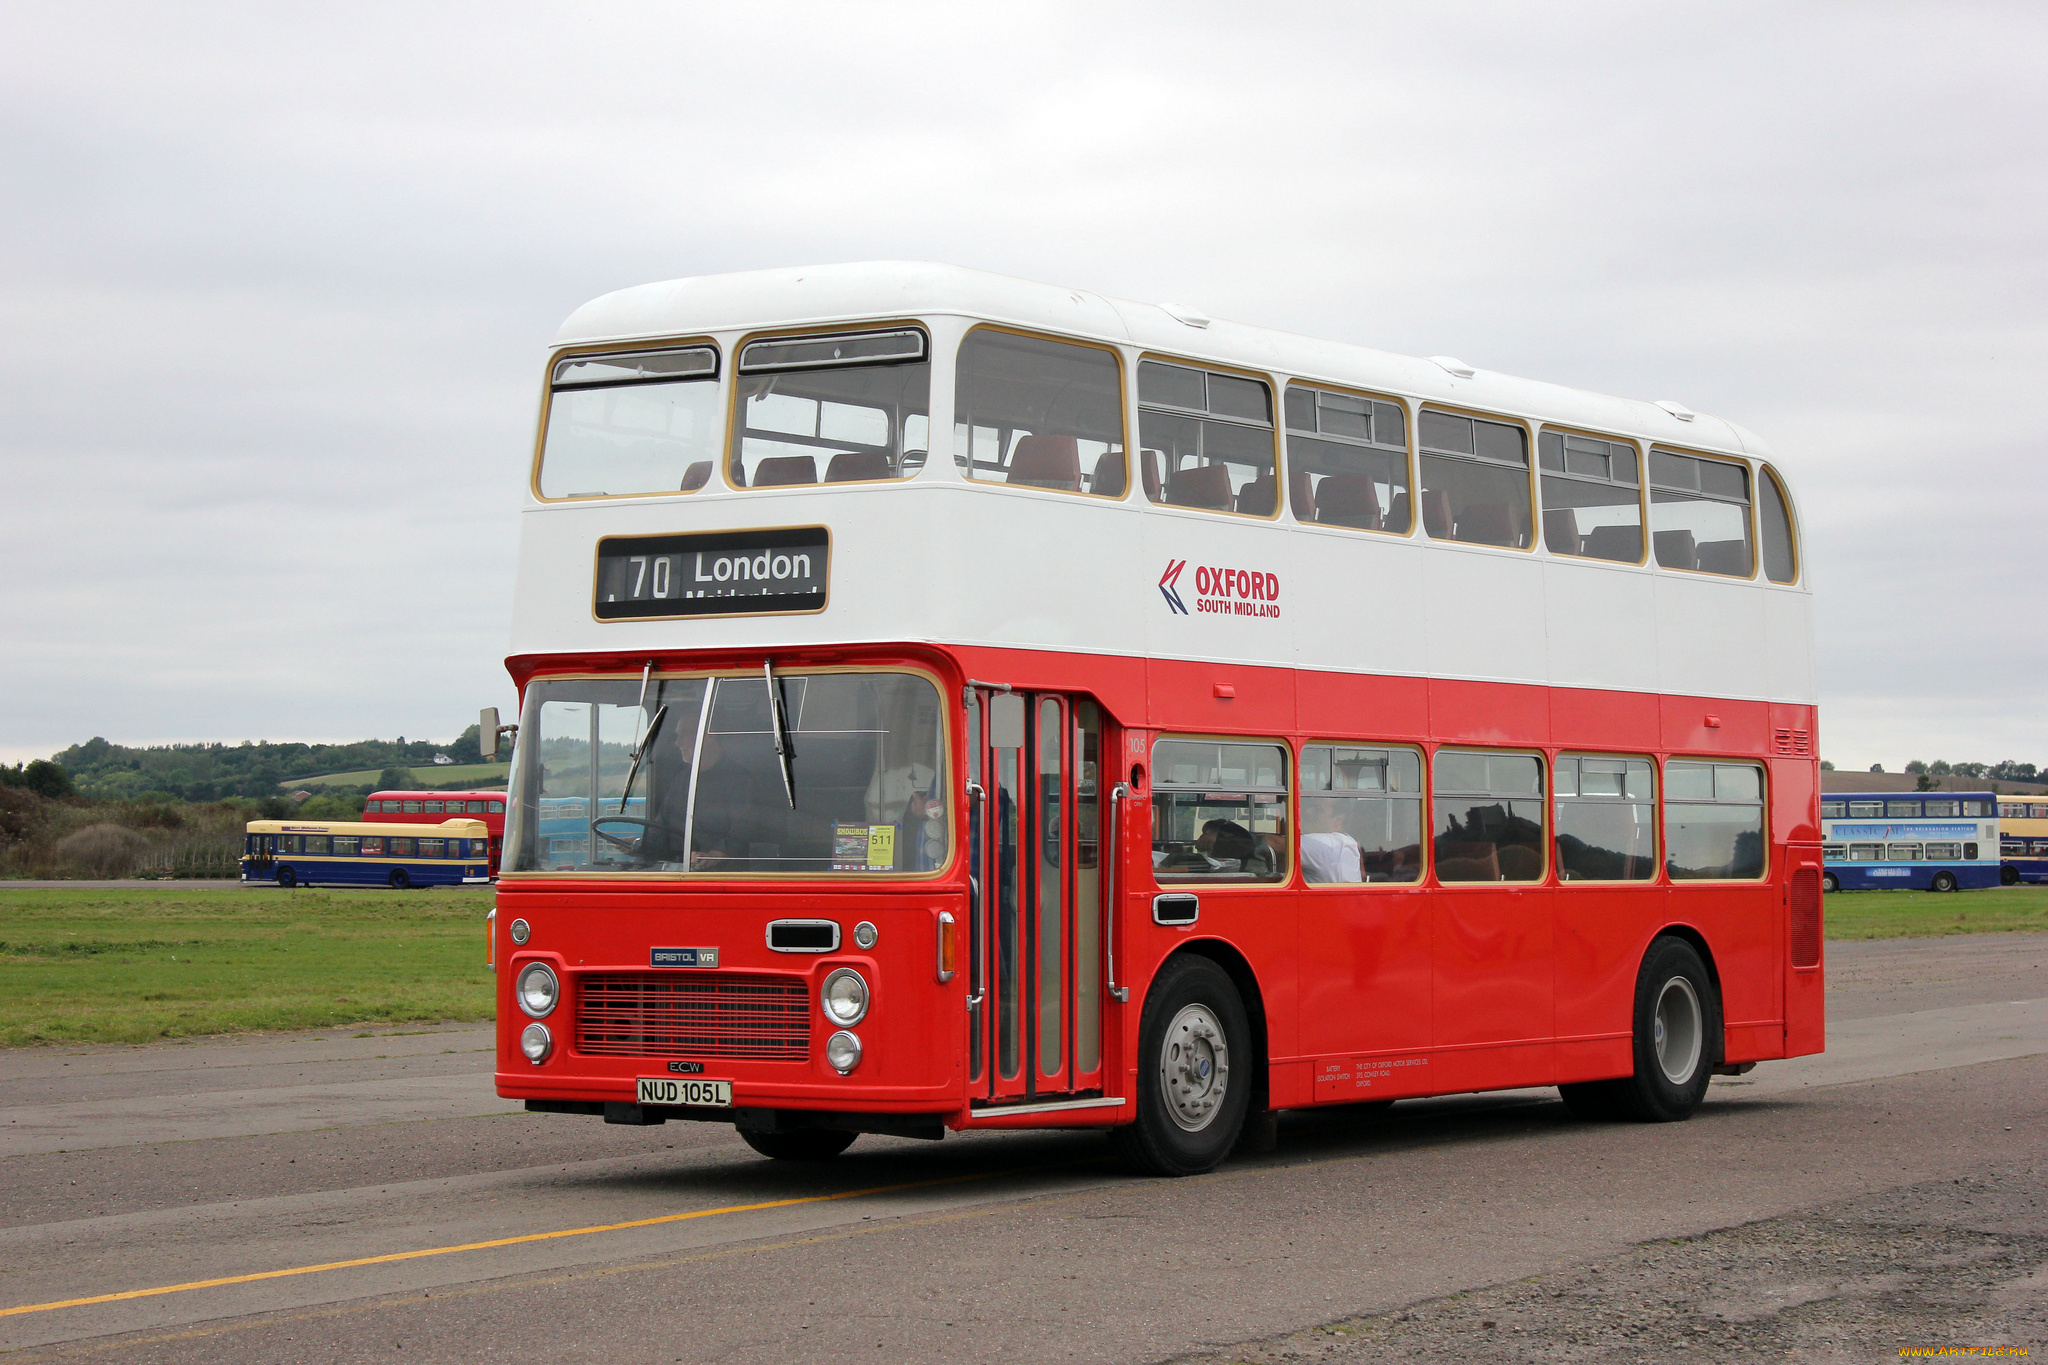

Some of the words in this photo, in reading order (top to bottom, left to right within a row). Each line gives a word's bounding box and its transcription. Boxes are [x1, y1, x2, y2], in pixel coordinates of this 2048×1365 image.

[629, 556, 671, 598] 70
[695, 549, 811, 582] London
[1195, 566, 1279, 601] OXFORD
[1197, 598, 1231, 615] SOUTH
[1234, 601, 1281, 618] MIDLAND
[1130, 738, 1146, 753] 105
[1835, 828, 1878, 836] CLASSIC
[871, 835, 891, 845] 511
[654, 953, 695, 961] BRISTOL
[700, 953, 714, 962] VR
[669, 1062, 700, 1073] ECW
[1364, 1070, 1379, 1078] COWLEY
[641, 1081, 678, 1101] NUD
[684, 1083, 727, 1103] 105L
